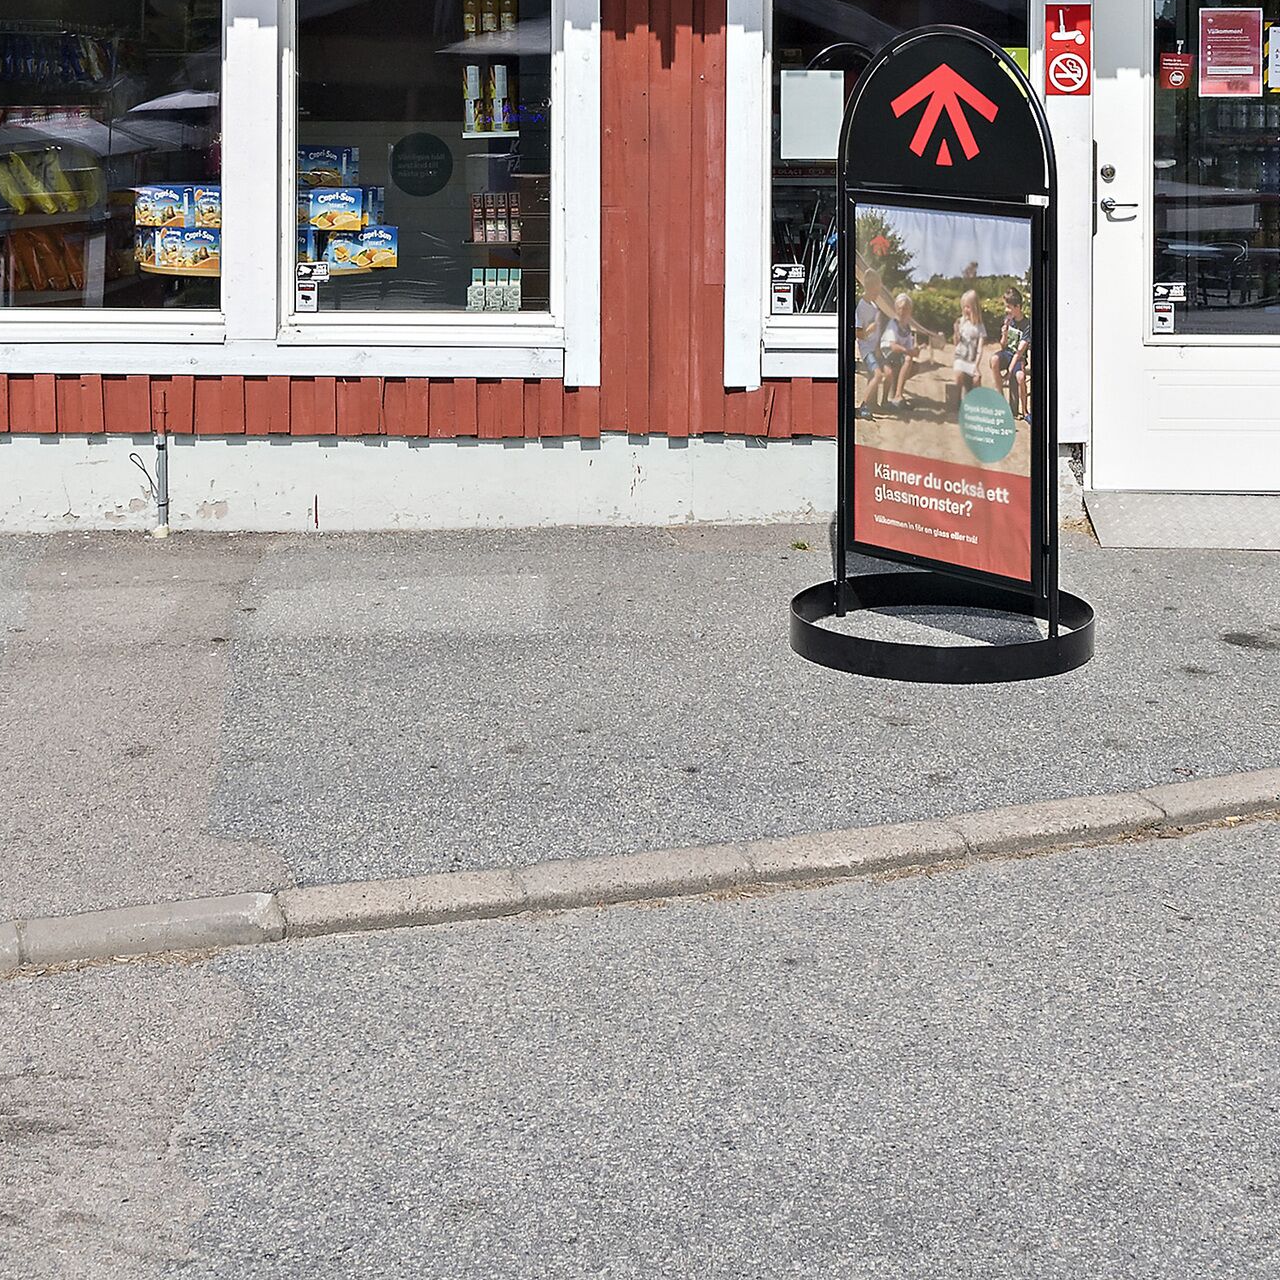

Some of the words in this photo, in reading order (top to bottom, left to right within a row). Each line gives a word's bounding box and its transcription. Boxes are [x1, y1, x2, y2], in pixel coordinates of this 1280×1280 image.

[308, 149, 338, 161] Capri-Sun
[154, 189, 180, 201] Capri-Sun
[318, 191, 356, 204] Capri-Sun
[184, 229, 215, 242] Capri-Sun
[358, 229, 392, 241] Capri-Sun
[874, 462, 923, 486] Känner
[923, 472, 941, 490] du
[944, 478, 986, 500] också
[986, 487, 1010, 504] ett
[874, 484, 974, 517] glassmonster?
[933, 528, 950, 539] glass
